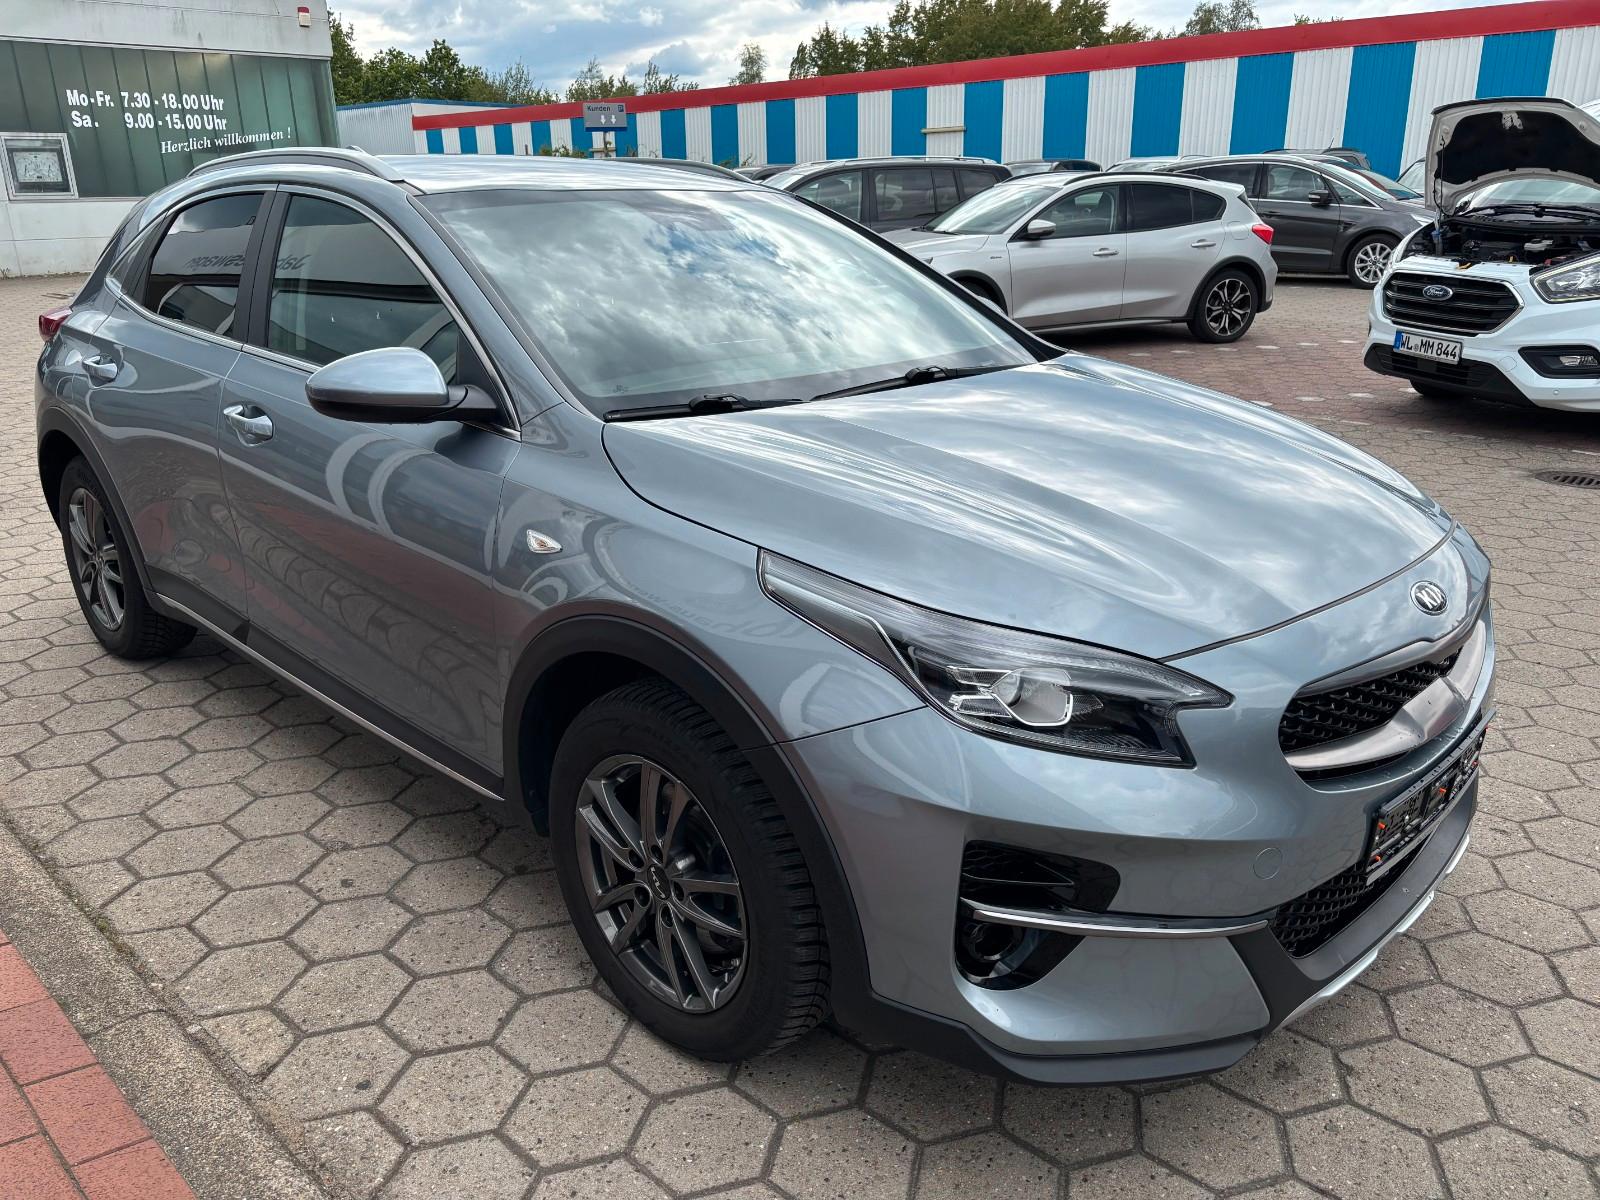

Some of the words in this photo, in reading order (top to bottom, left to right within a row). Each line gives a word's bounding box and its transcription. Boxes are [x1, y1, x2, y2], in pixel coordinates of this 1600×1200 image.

[121, 91, 151, 108] 7.30
[162, 92, 199, 109] 18.00
[200, 94, 225, 111] Uhr
[71, 110, 99, 128] Sa.
[124, 112, 155, 129] 9.00
[165, 113, 202, 130] 15.00
[204, 114, 227, 131] Uhr
[161, 136, 212, 154] Herzlich
[214, 131, 284, 147] willkommen
[1427, 287, 1444, 297] Ford
[1400, 334, 1413, 351] WL
[1420, 338, 1435, 355] MM
[1436, 342, 1457, 360] 844
